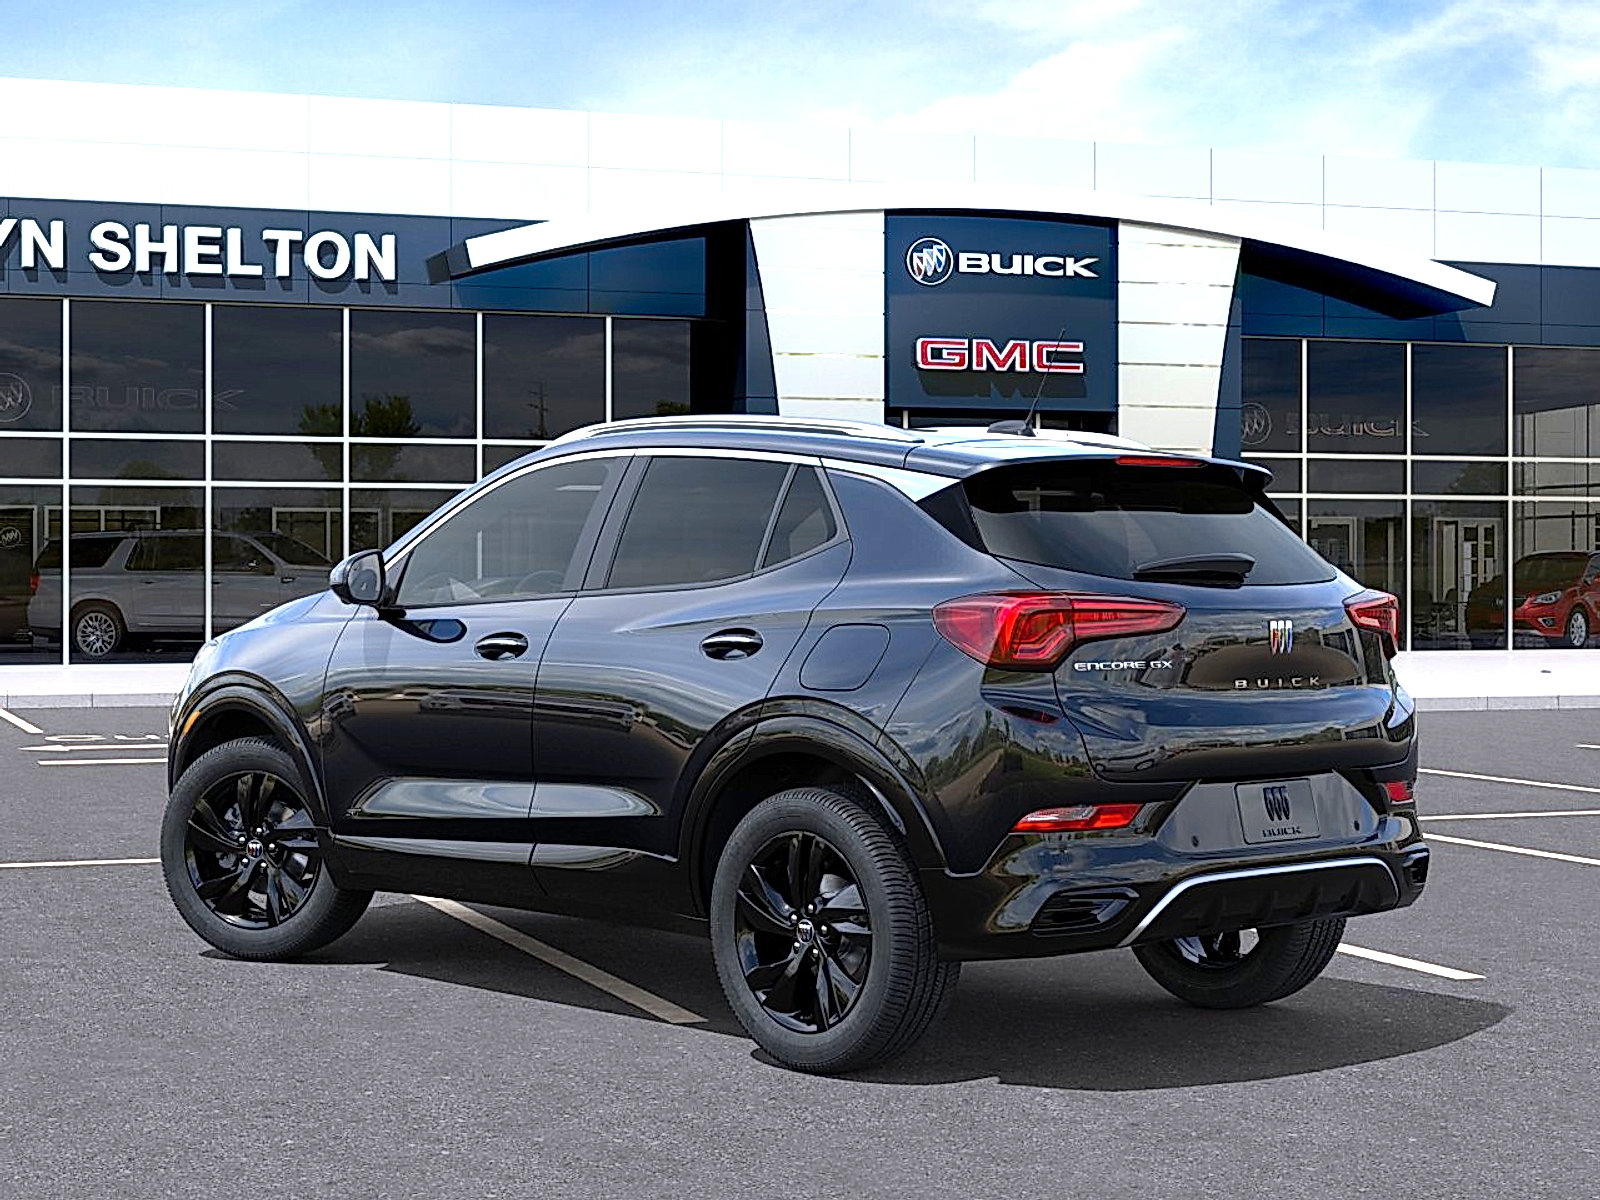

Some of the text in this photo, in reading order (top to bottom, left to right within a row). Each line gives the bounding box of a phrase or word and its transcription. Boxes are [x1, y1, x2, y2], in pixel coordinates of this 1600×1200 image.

[88, 221, 397, 282] SHELTON
[958, 251, 1100, 278] BUICK
[915, 336, 1085, 374] GMC
[1073, 660, 1174, 672] ENCORE GX
[1233, 676, 1321, 690] BUICK
[1261, 825, 1302, 838] BUICK
